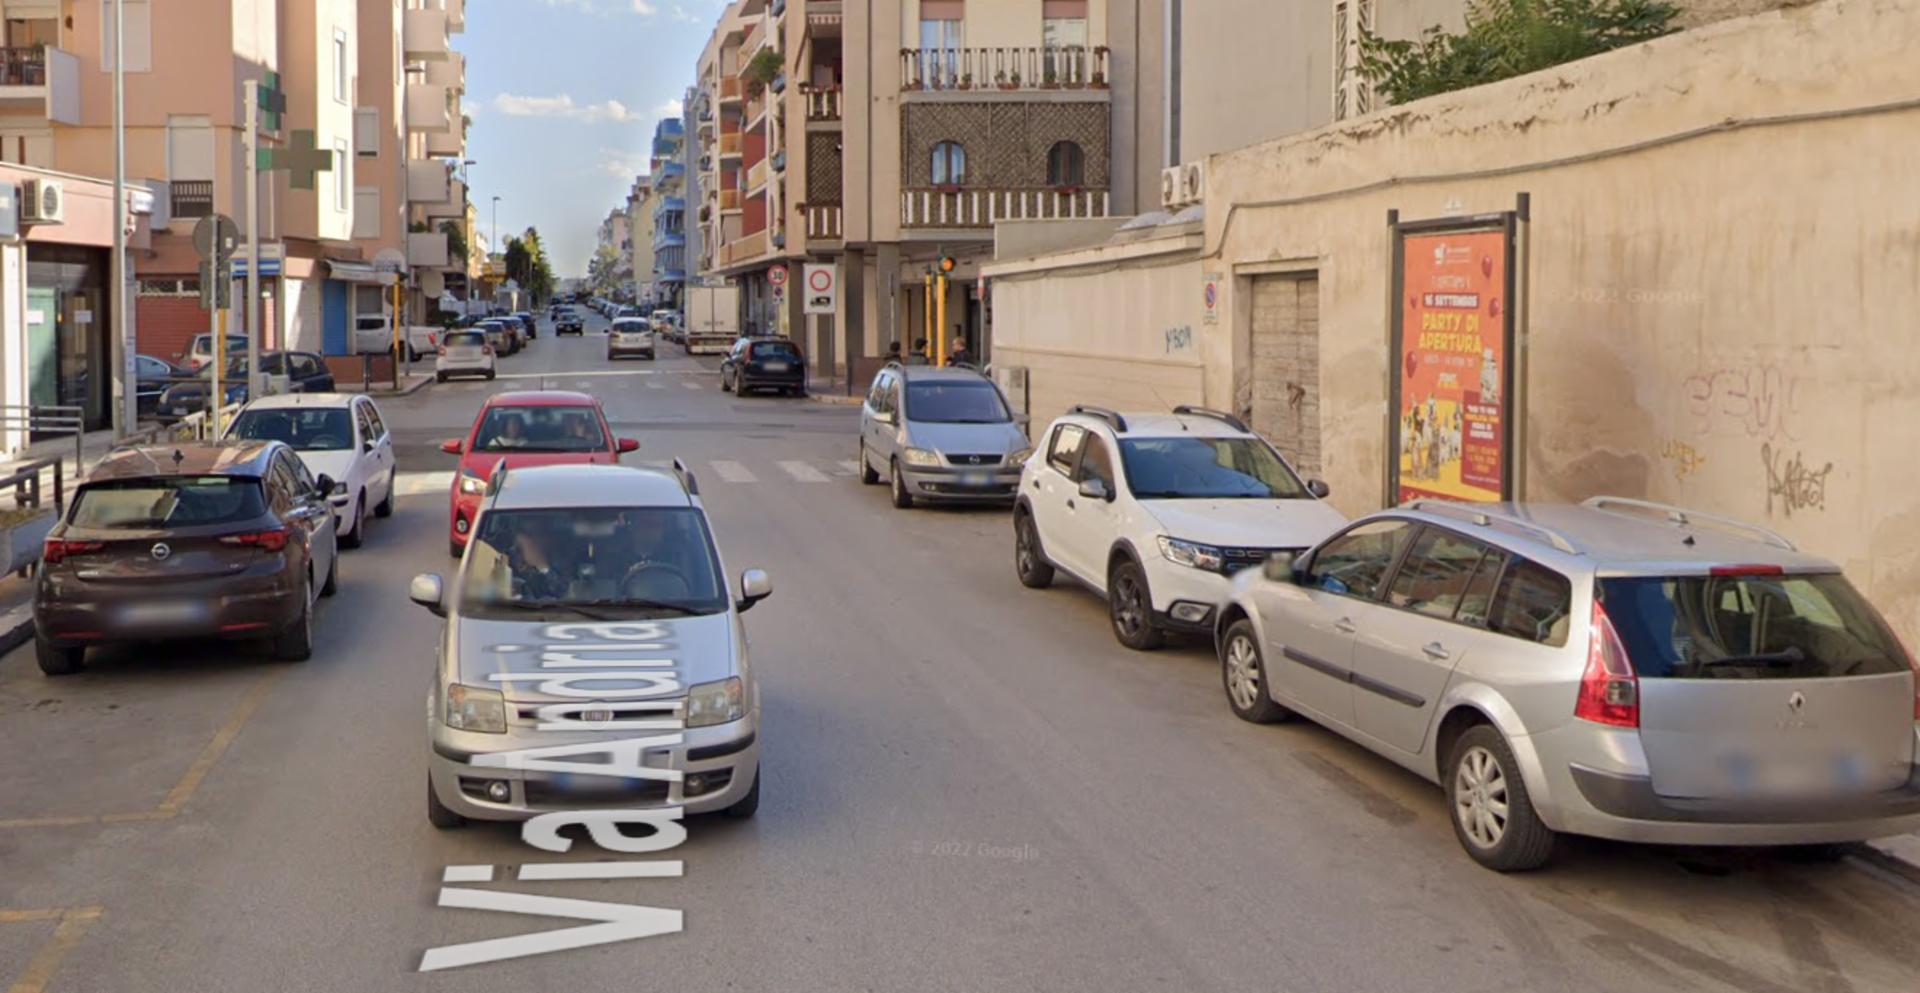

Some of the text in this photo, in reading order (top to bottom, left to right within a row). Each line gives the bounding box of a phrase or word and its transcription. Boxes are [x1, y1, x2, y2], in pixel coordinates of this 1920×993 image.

[1422, 311, 1480, 333] PARTY DI
[1418, 332, 1482, 354] APERTURA
